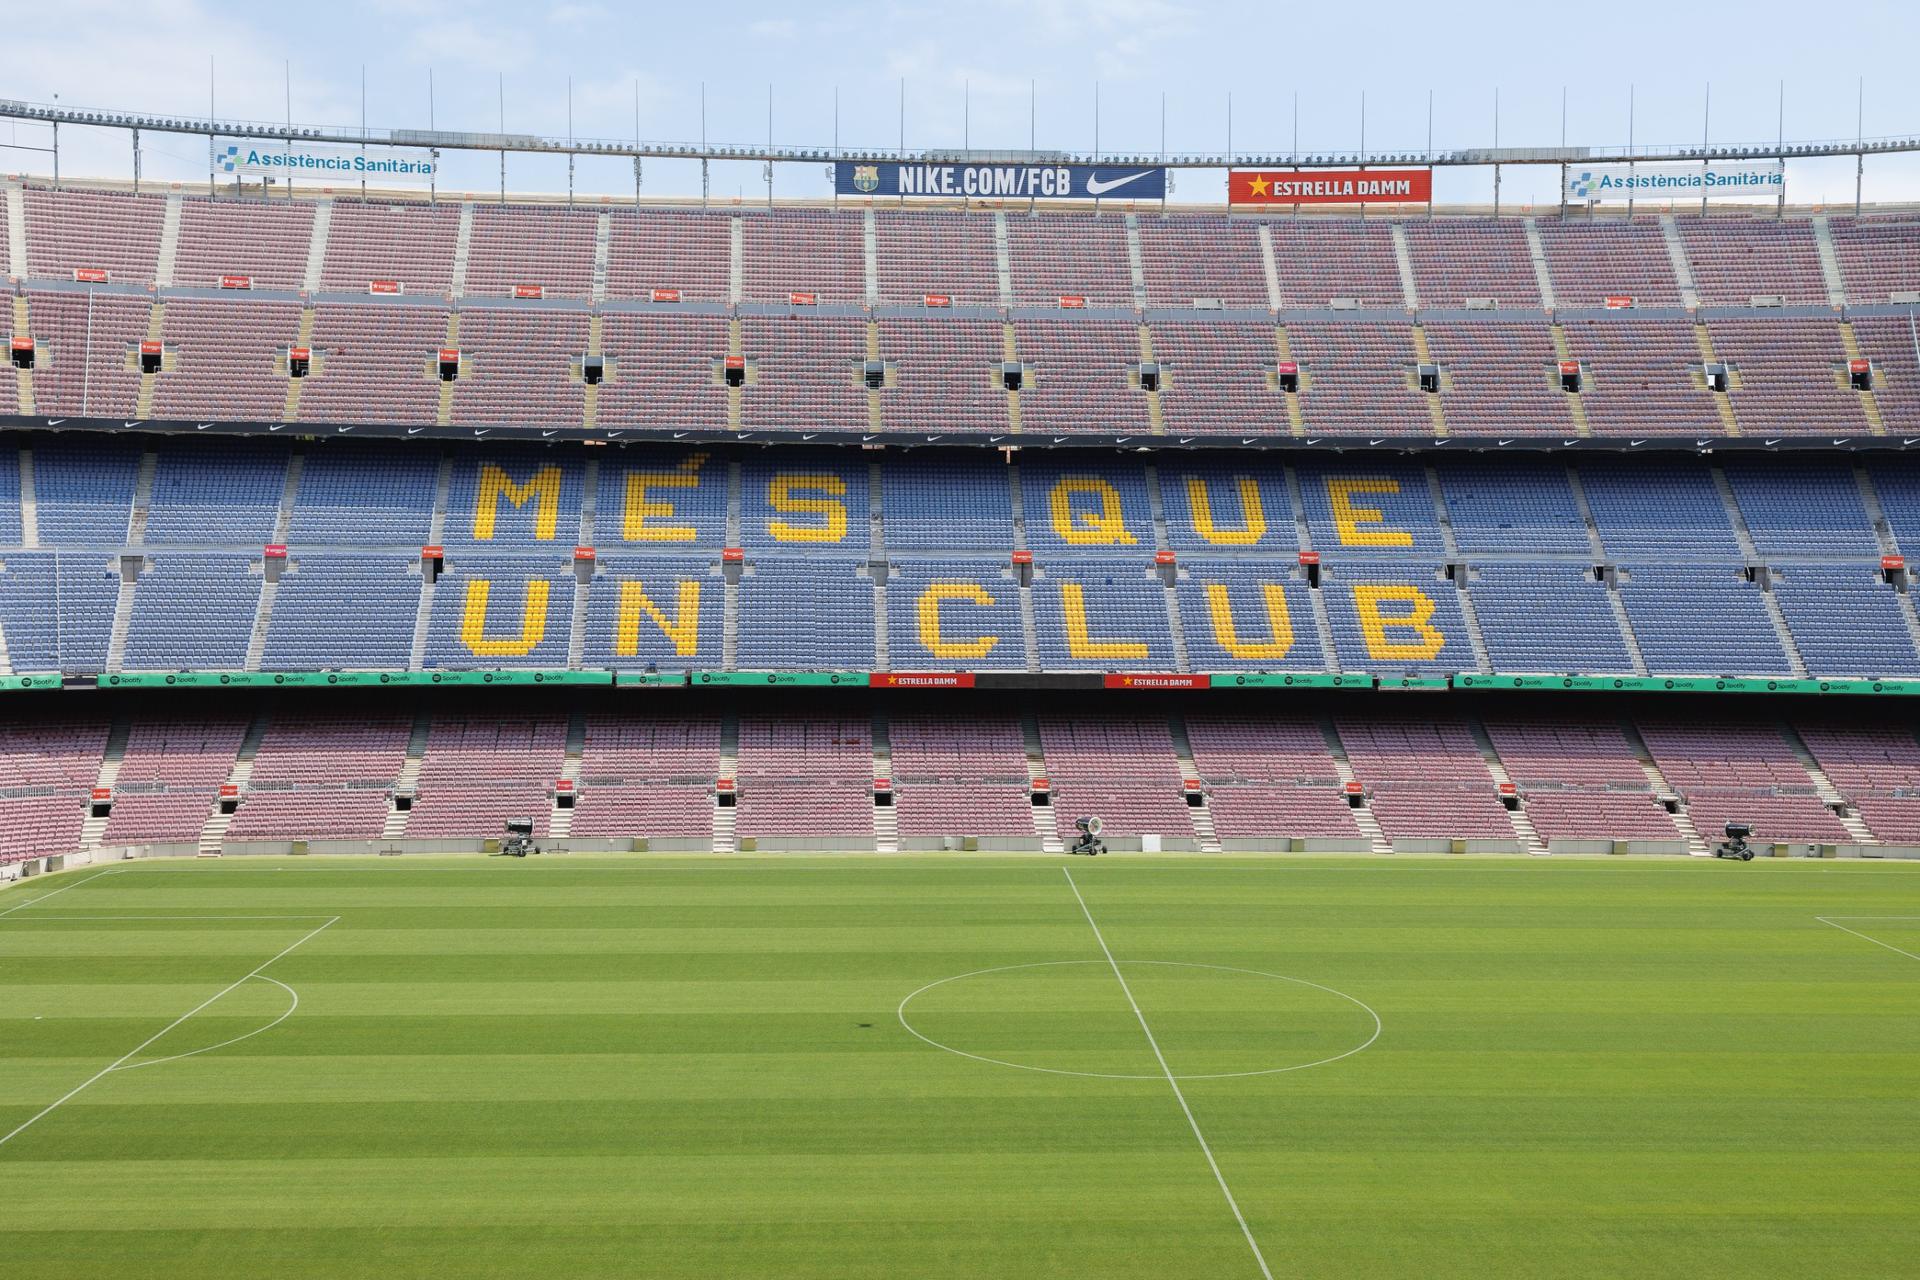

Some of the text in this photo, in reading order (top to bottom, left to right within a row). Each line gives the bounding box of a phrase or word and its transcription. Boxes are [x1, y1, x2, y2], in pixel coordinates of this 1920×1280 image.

[247, 149, 432, 175] Assistència Sanitària
[898, 166, 1071, 195] NIKE.COM/FCB
[1600, 170, 1782, 189] Assistència Sanitària
[1273, 180, 1410, 196] ESTRELLA DAMM
[474, 453, 1413, 547] MÉS QUE
[460, 579, 1445, 660] UN CLUB
[494, 674, 513, 682] Spotify
[545, 674, 564, 682] Spotify
[777, 675, 796, 683] Spotify
[898, 677, 957, 685] ESTRELLA DAMM
[1134, 678, 1193, 686] ESTRELLA DAMM
[1294, 677, 1313, 685] Spotify
[1573, 679, 1593, 687] Spotify
[1624, 680, 1644, 688] Spotify
[1726, 681, 1746, 689] Spotify
[1778, 682, 1798, 690] Spotify
